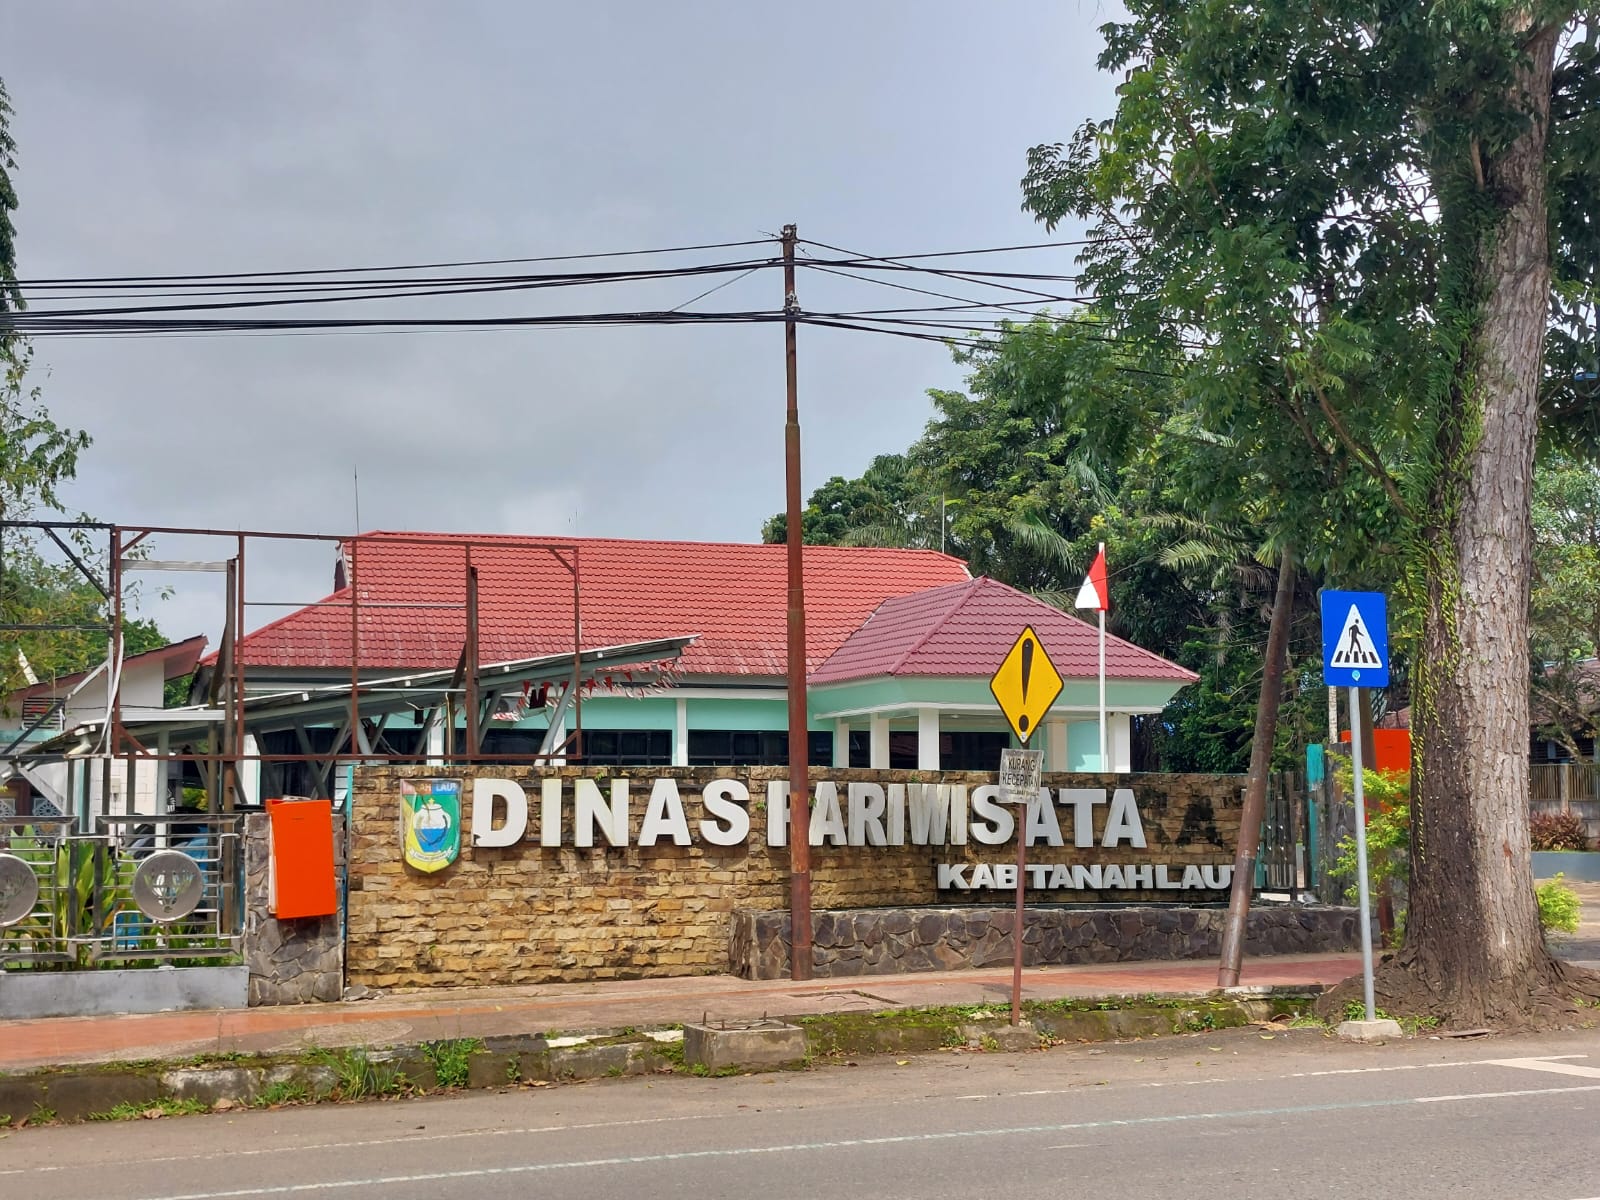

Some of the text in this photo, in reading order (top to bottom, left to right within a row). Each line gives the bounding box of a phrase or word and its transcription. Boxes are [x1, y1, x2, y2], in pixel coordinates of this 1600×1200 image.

[1008, 757, 1036, 771] KURANG
[1002, 773, 1040, 788] KECEPATAN
[471, 778, 750, 848] DINAS
[937, 863, 1019, 890] KAB
[1155, 864, 1236, 890] LAU
